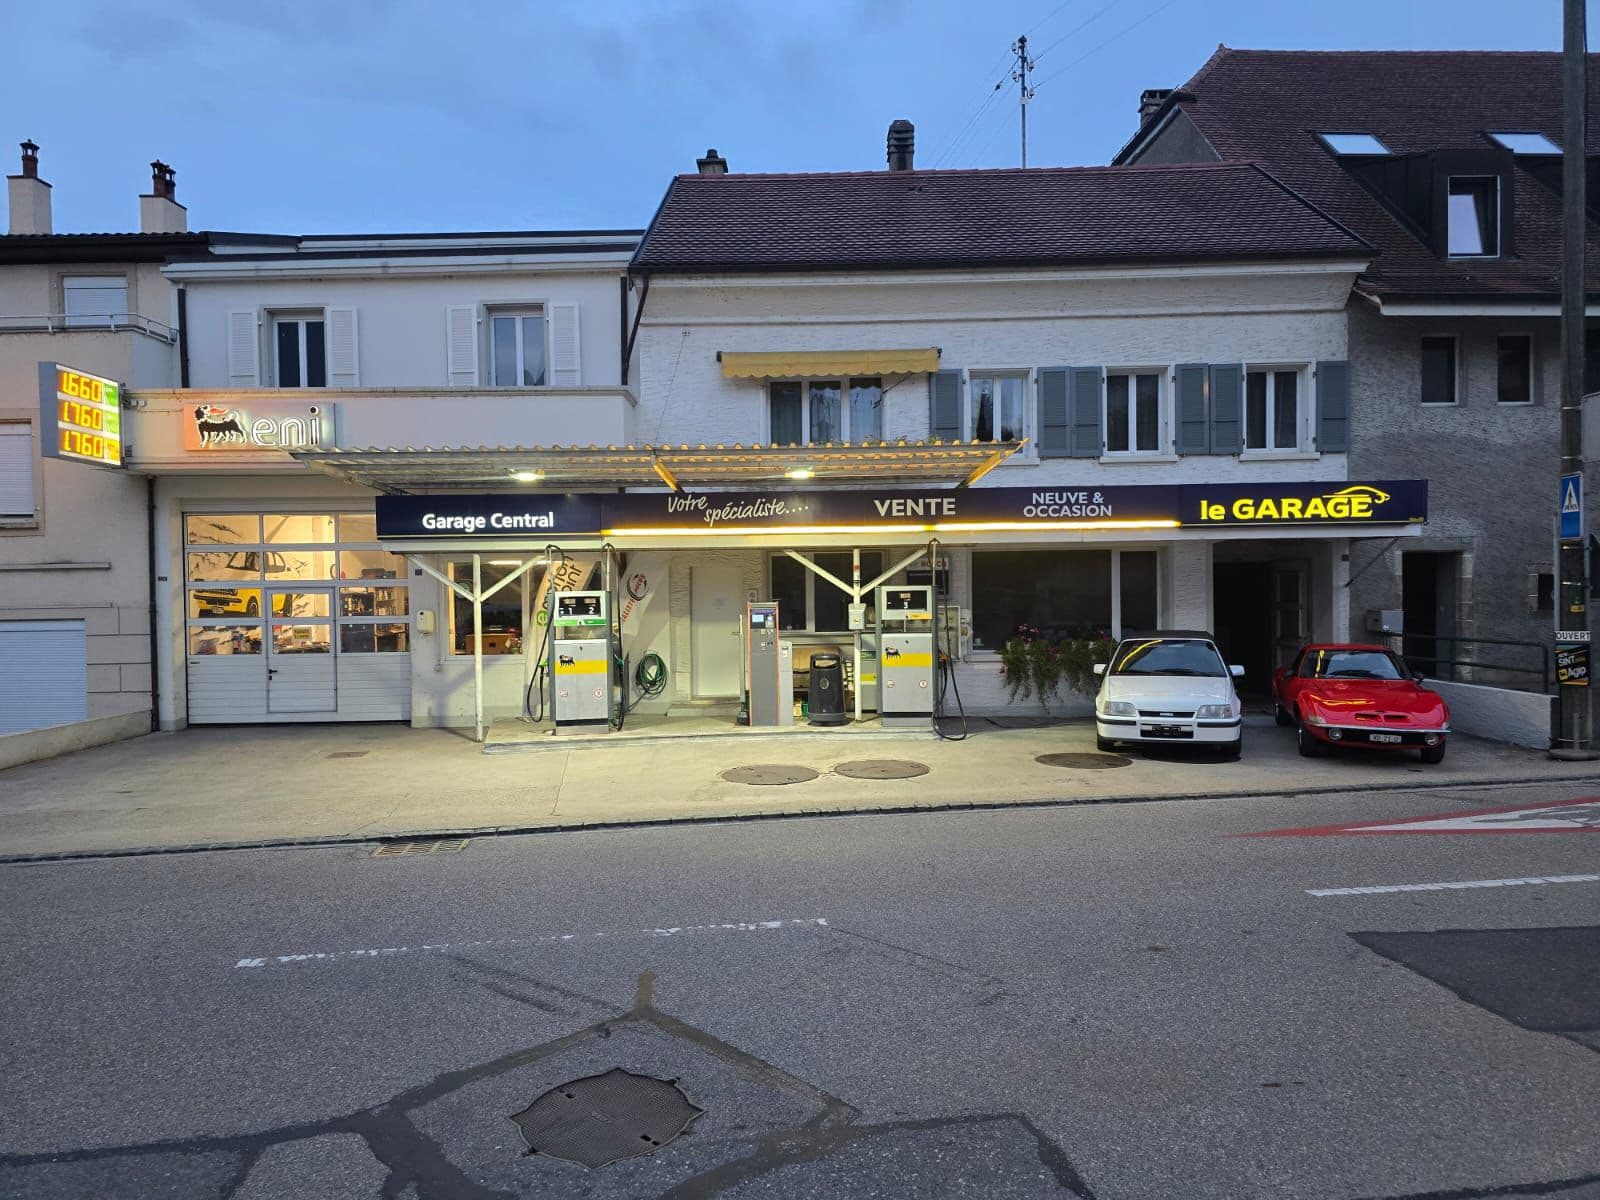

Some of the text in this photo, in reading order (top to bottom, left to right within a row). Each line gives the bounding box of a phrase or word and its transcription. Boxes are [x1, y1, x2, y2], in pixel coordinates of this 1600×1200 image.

[252, 406, 319, 447] eni
[668, 495, 708, 513] Votre
[1032, 491, 1104, 504] NEUVE &
[874, 498, 956, 517] VENTE
[1023, 504, 1112, 517] OCCASION
[1200, 497, 1373, 519] le GARAGE
[422, 511, 554, 533] Garage Central
[1555, 631, 1591, 641] OUVERT
